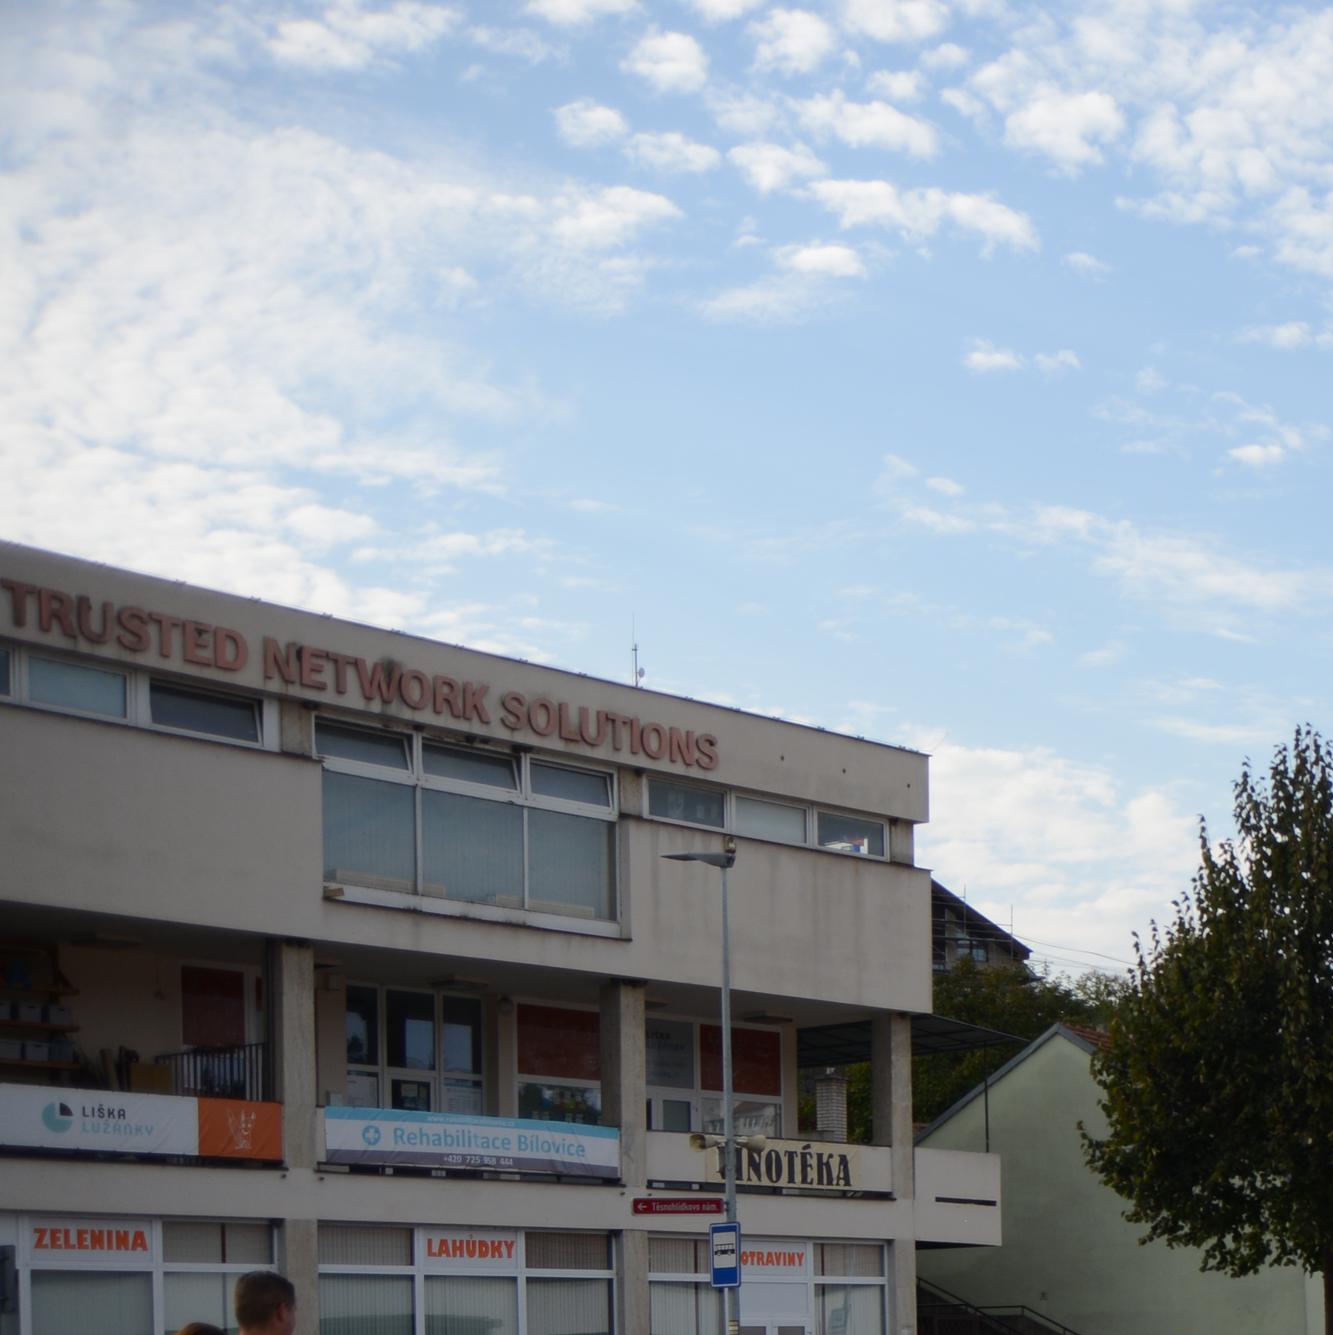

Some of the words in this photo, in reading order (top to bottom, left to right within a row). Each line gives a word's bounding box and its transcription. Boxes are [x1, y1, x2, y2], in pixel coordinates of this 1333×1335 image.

[2, 578, 249, 671] TRUSTED
[263, 636, 491, 725] NETWORK
[499, 691, 719, 770] SOLUTIONS
[81, 1104, 127, 1120] LIŠKA
[393, 1127, 512, 1150] Rehabilitace
[516, 1134, 586, 1157] Bílovice
[33, 1228, 149, 1251] ZELENINA
[740, 1251, 805, 1267] OTRAVINY
